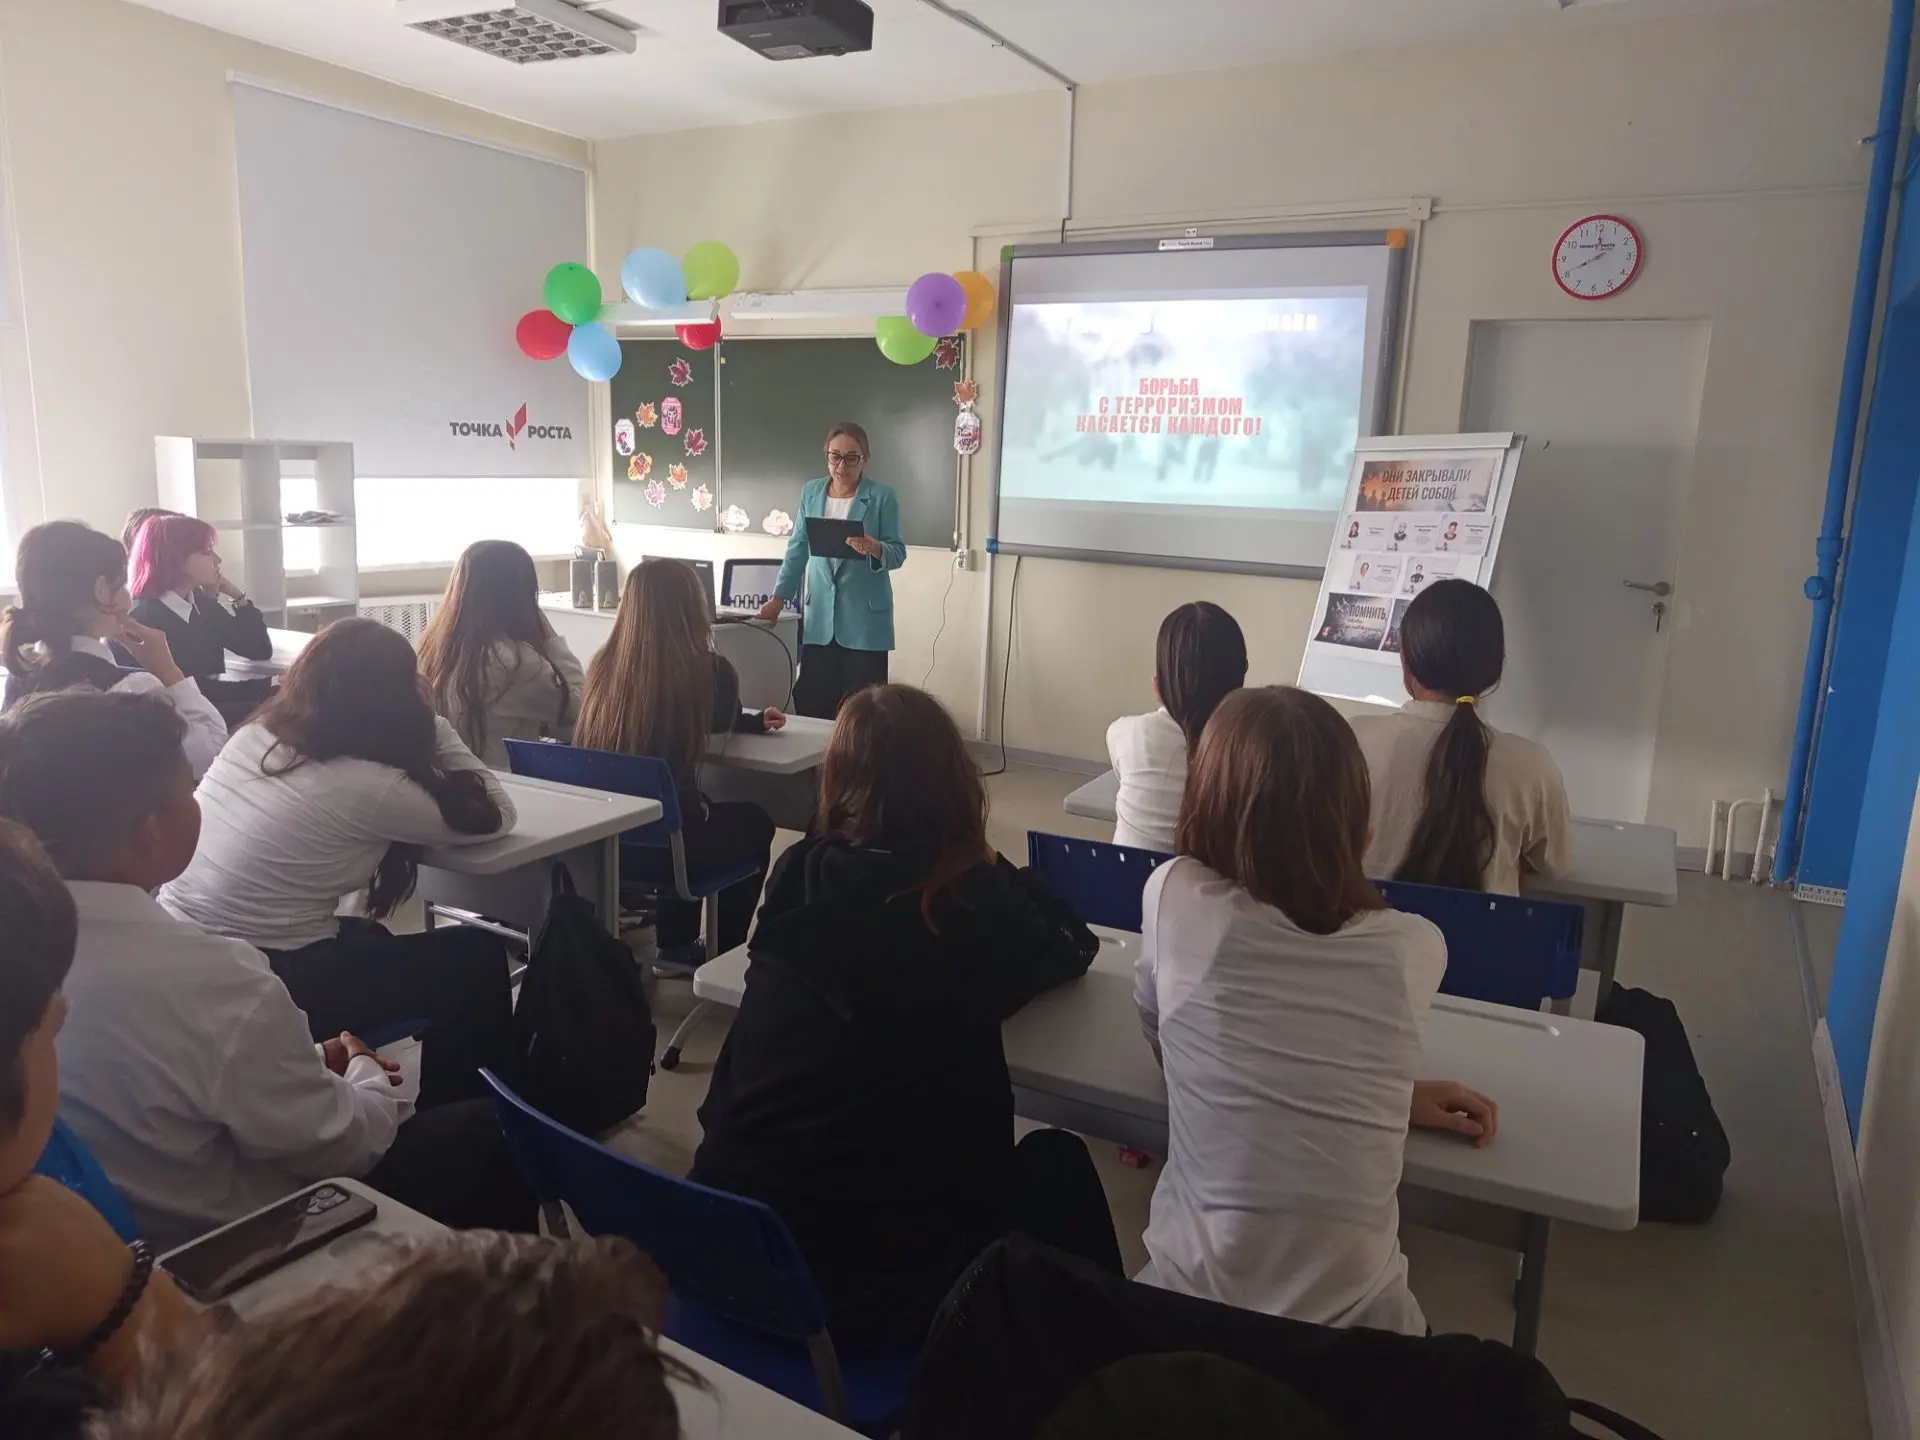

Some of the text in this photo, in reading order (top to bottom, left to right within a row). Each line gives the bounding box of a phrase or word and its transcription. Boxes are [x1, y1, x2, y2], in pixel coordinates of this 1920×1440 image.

[1595, 223, 1605, 233] 12
[1580, 229, 1589, 238] 11
[1567, 241, 1577, 249] 10
[1623, 237, 1629, 245] 2
[1625, 252, 1632, 261] 3
[1564, 271, 1571, 279] 8
[1619, 268, 1625, 276] 4
[1575, 280, 1581, 288] 7
[1591, 283, 1597, 292] 6
[1606, 279, 1613, 287] 5
[1138, 377, 1199, 396] БОРЬБА
[1099, 396, 1243, 416] С ТЕРРОРИЗМОМ
[449, 422, 572, 440] ТОЧКА РОСТА
[1076, 415, 1262, 438] КАСАЕТСЯ КАЖДОГО!
[1382, 469, 1472, 484] ОНИ ЗАКРЫВАЛИ
[1387, 483, 1457, 502] ДЕТЕЙ СОБОЙ
